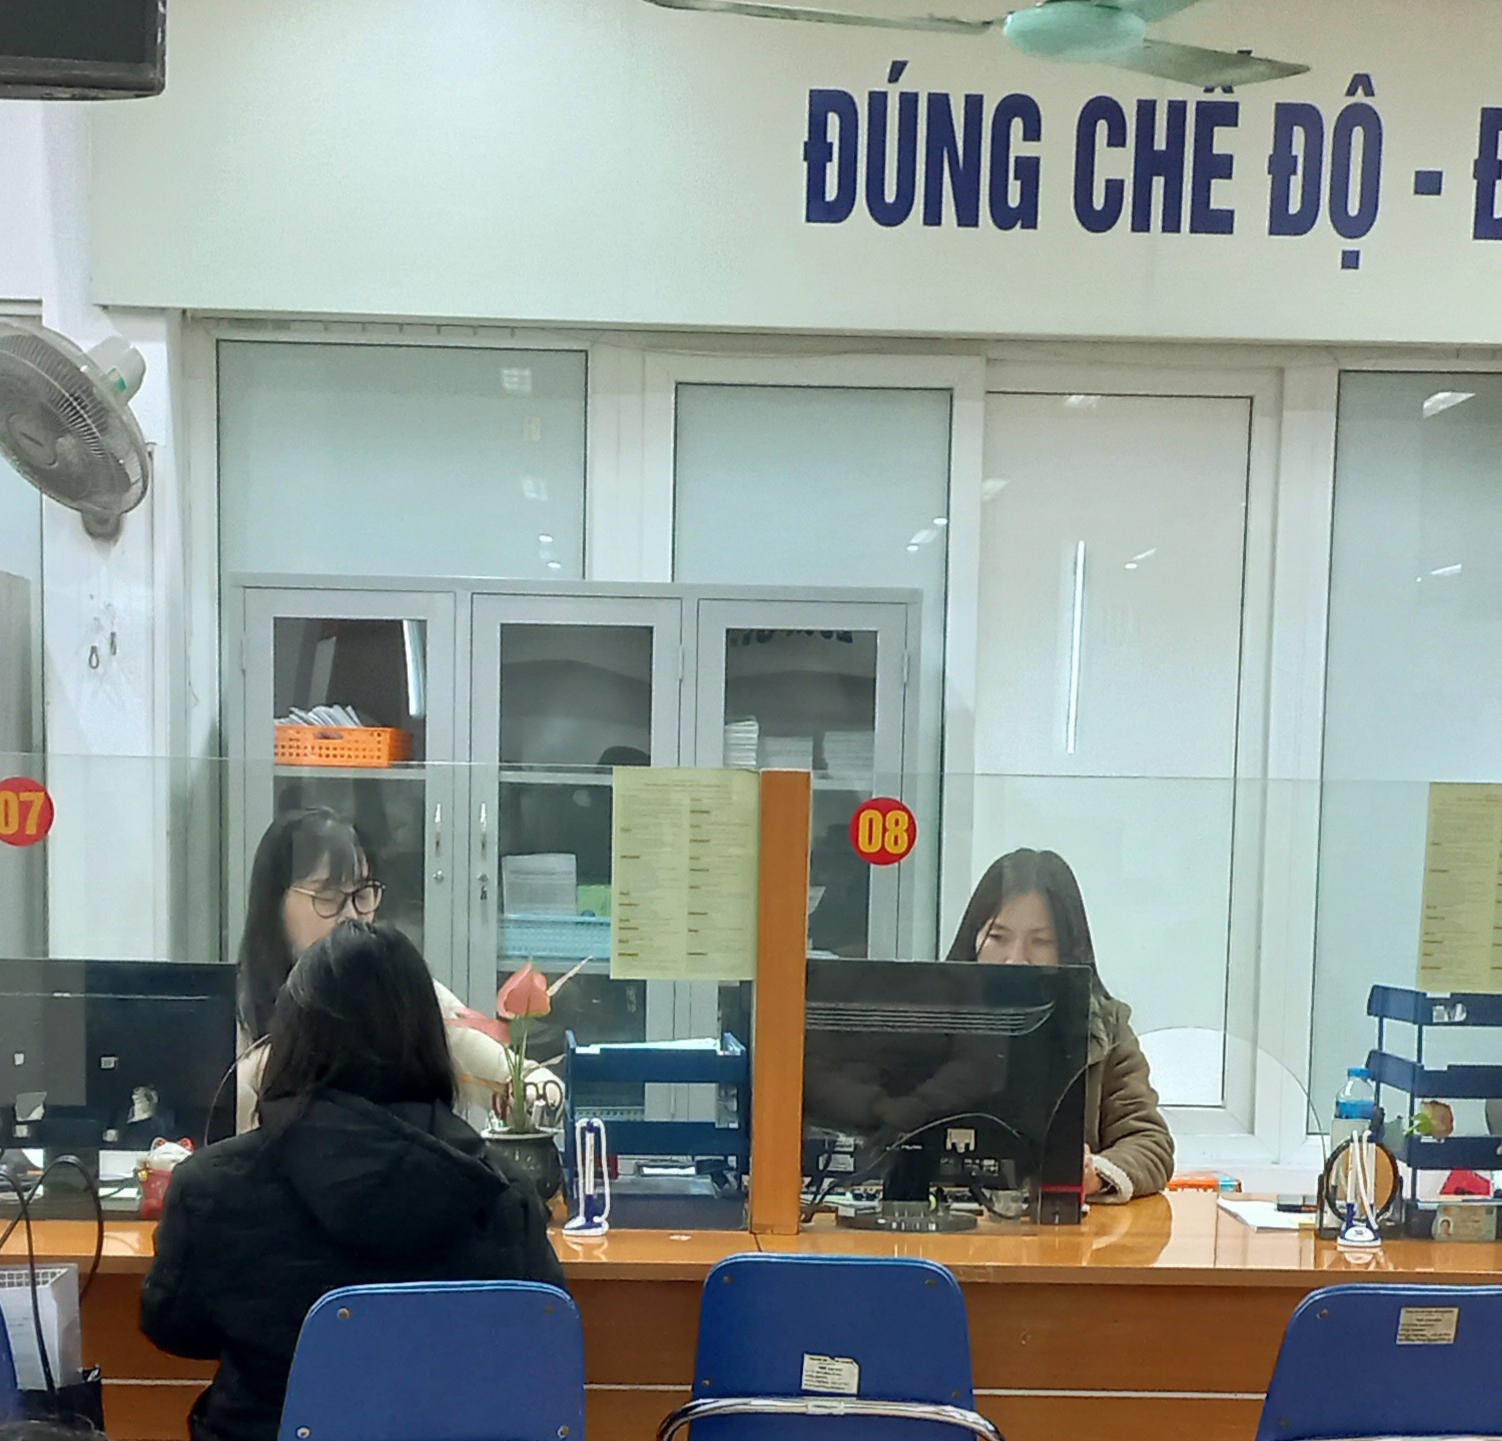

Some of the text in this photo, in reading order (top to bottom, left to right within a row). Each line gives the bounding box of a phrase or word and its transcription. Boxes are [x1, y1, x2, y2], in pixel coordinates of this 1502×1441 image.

[803, 60, 1043, 230] ĐÚNG
[1267, 73, 1384, 270] ĐỘ
[858, 808, 909, 855] 08
